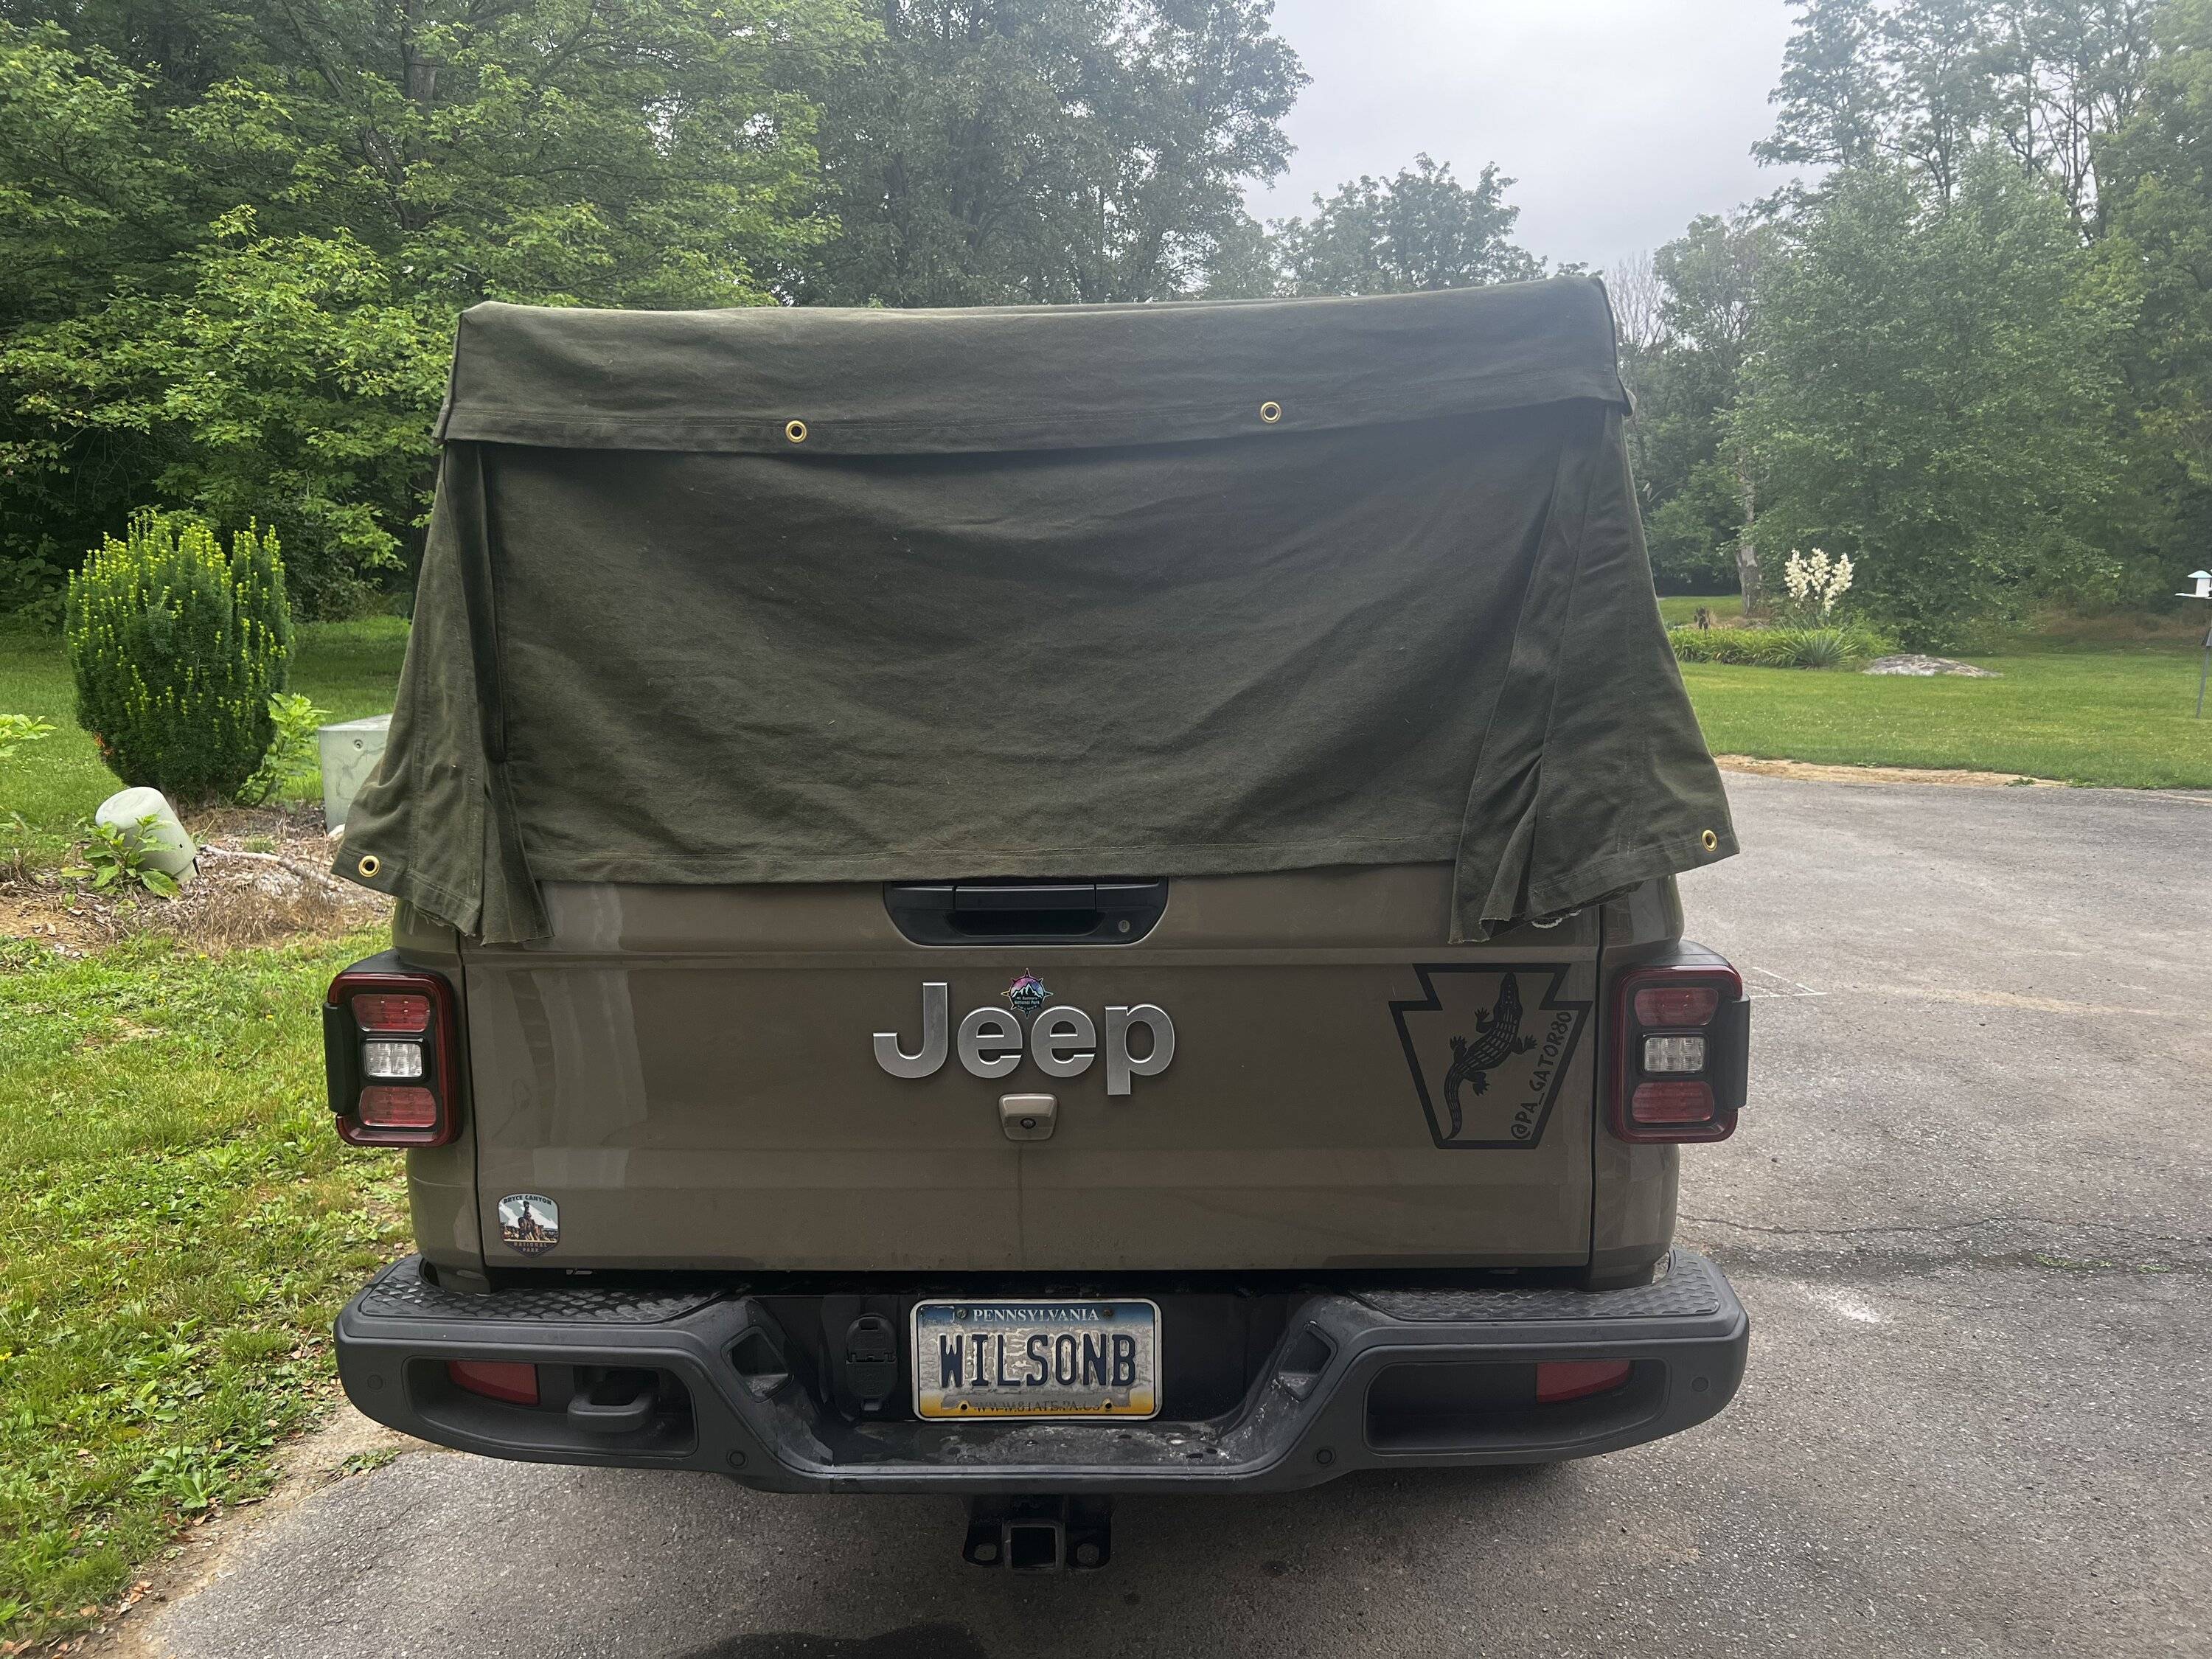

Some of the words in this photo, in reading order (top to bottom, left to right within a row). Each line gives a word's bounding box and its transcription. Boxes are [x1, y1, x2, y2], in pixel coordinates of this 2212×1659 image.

[873, 981, 1175, 1096] Jeep
[1512, 1011, 1572, 1139] @PA_GATOR80
[504, 1195, 523, 1204] BRYCE
[525, 1195, 552, 1205] CANYON
[973, 1308, 1099, 1323] PENNSYLVANIA
[939, 1333, 1136, 1388] WILSONB
